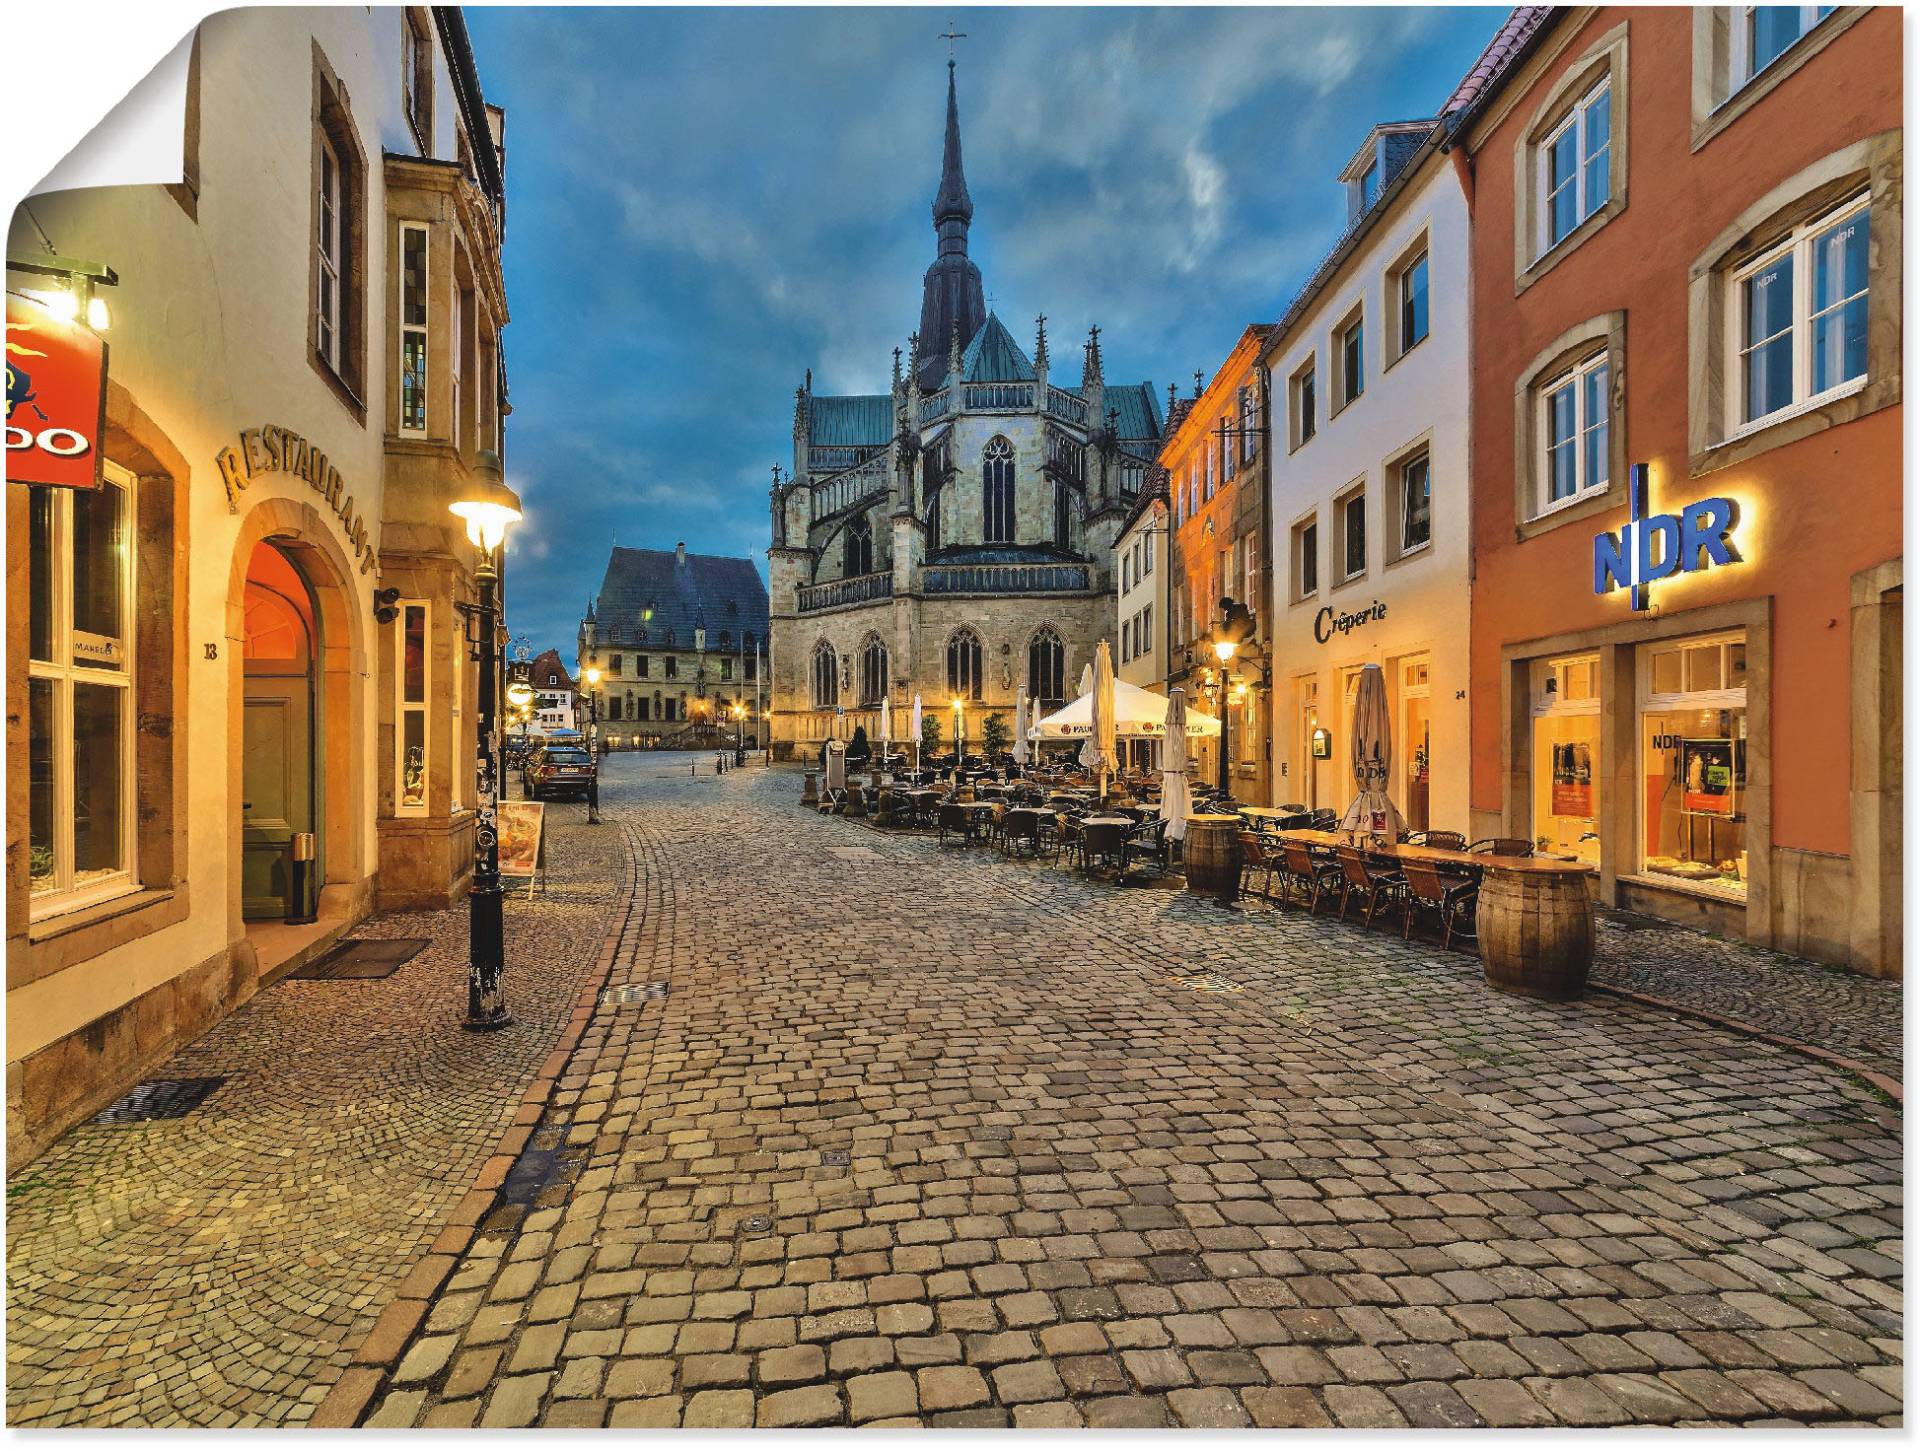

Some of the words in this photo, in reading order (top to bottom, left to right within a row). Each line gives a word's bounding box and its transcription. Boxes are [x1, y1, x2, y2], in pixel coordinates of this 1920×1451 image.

[1831, 226, 1855, 247] NDR
[1757, 272, 1777, 290] NDR
[215, 424, 376, 576] RESTAURANT
[1594, 496, 1738, 595] NDR
[1314, 600, 1387, 644] Crêperie
[204, 643, 218, 661] 13
